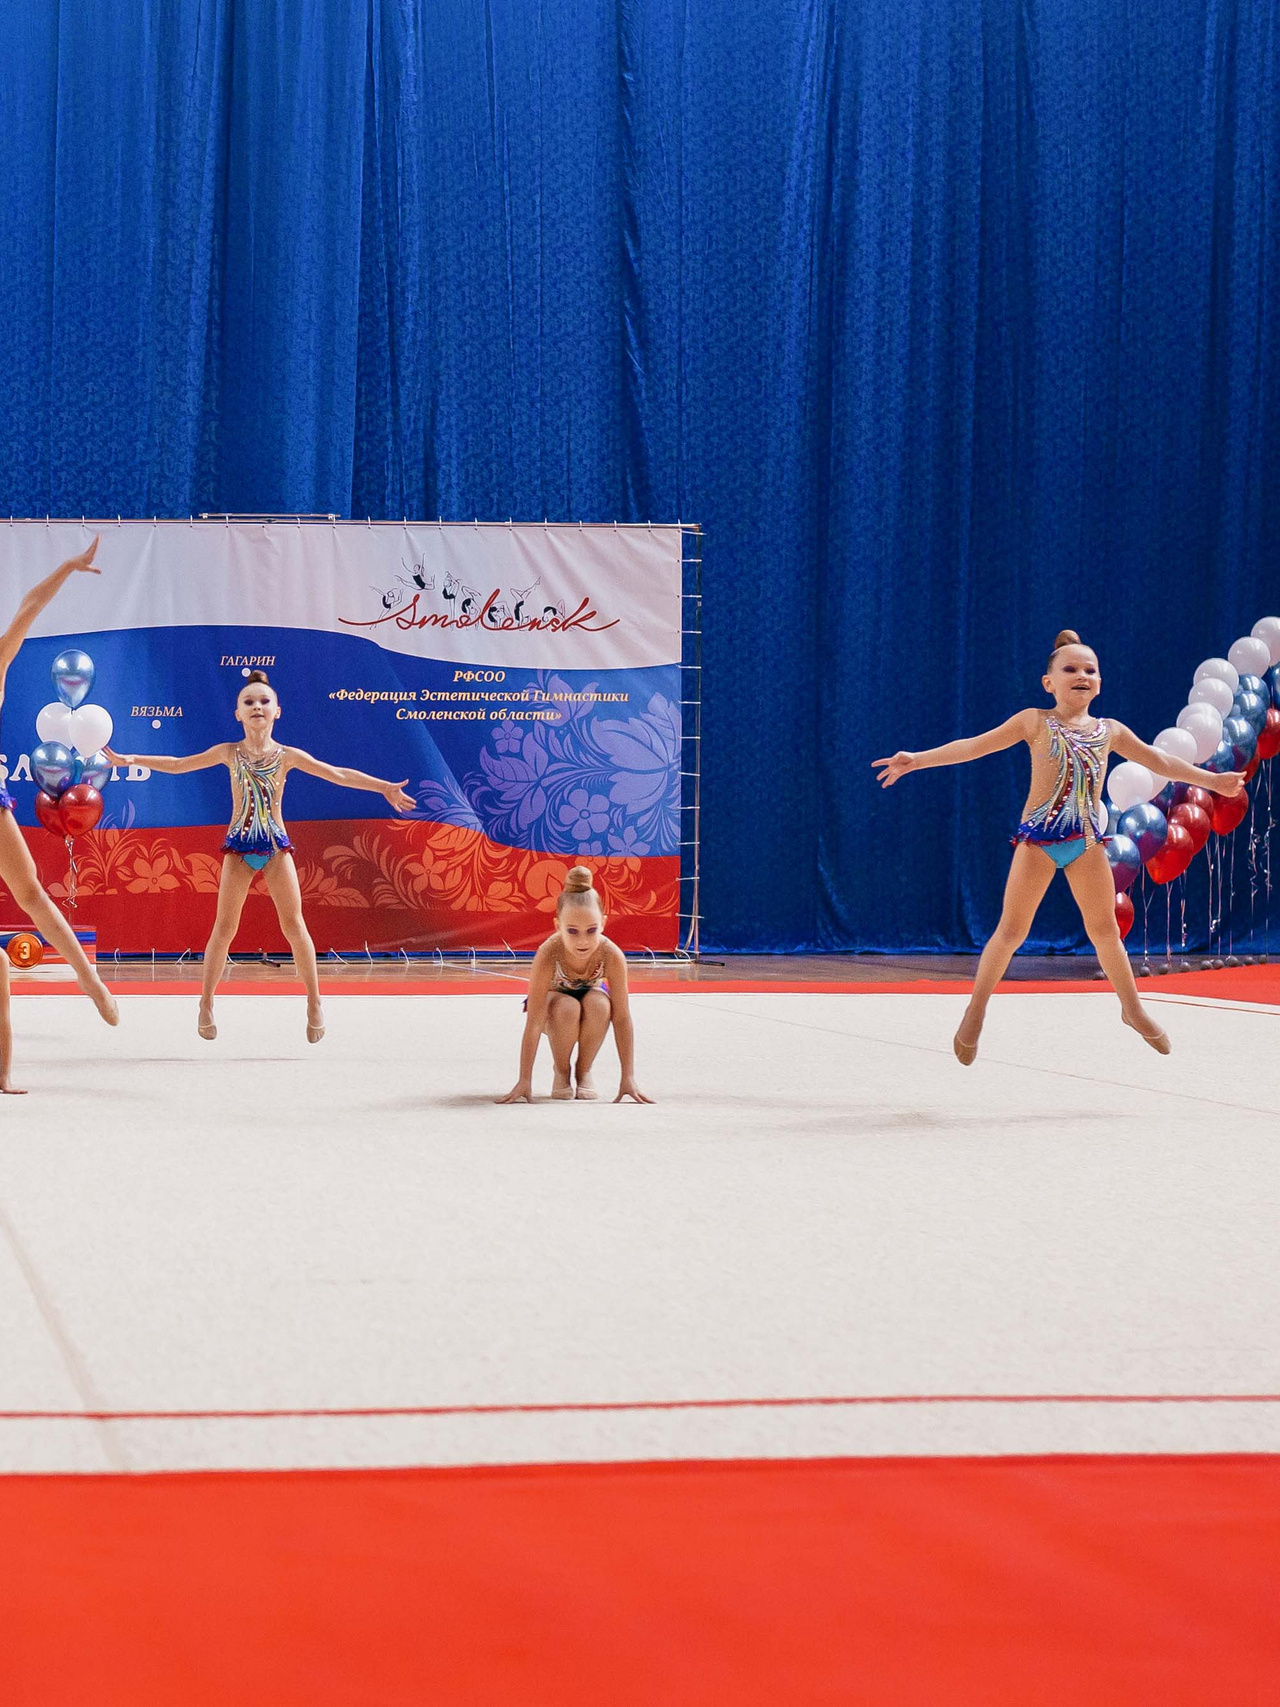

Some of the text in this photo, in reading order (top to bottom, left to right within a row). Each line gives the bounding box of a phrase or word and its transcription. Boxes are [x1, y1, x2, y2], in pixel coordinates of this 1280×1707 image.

[220, 655, 276, 667] ГАГАРИН
[453, 670, 506, 682] РФСОО
[328, 688, 629, 704] «Федерация Эстетической Гимнастики
[130, 706, 184, 717] ВЯЗЬМА
[395, 706, 562, 720] Смоленской области»
[19, 941, 31, 960] 3
